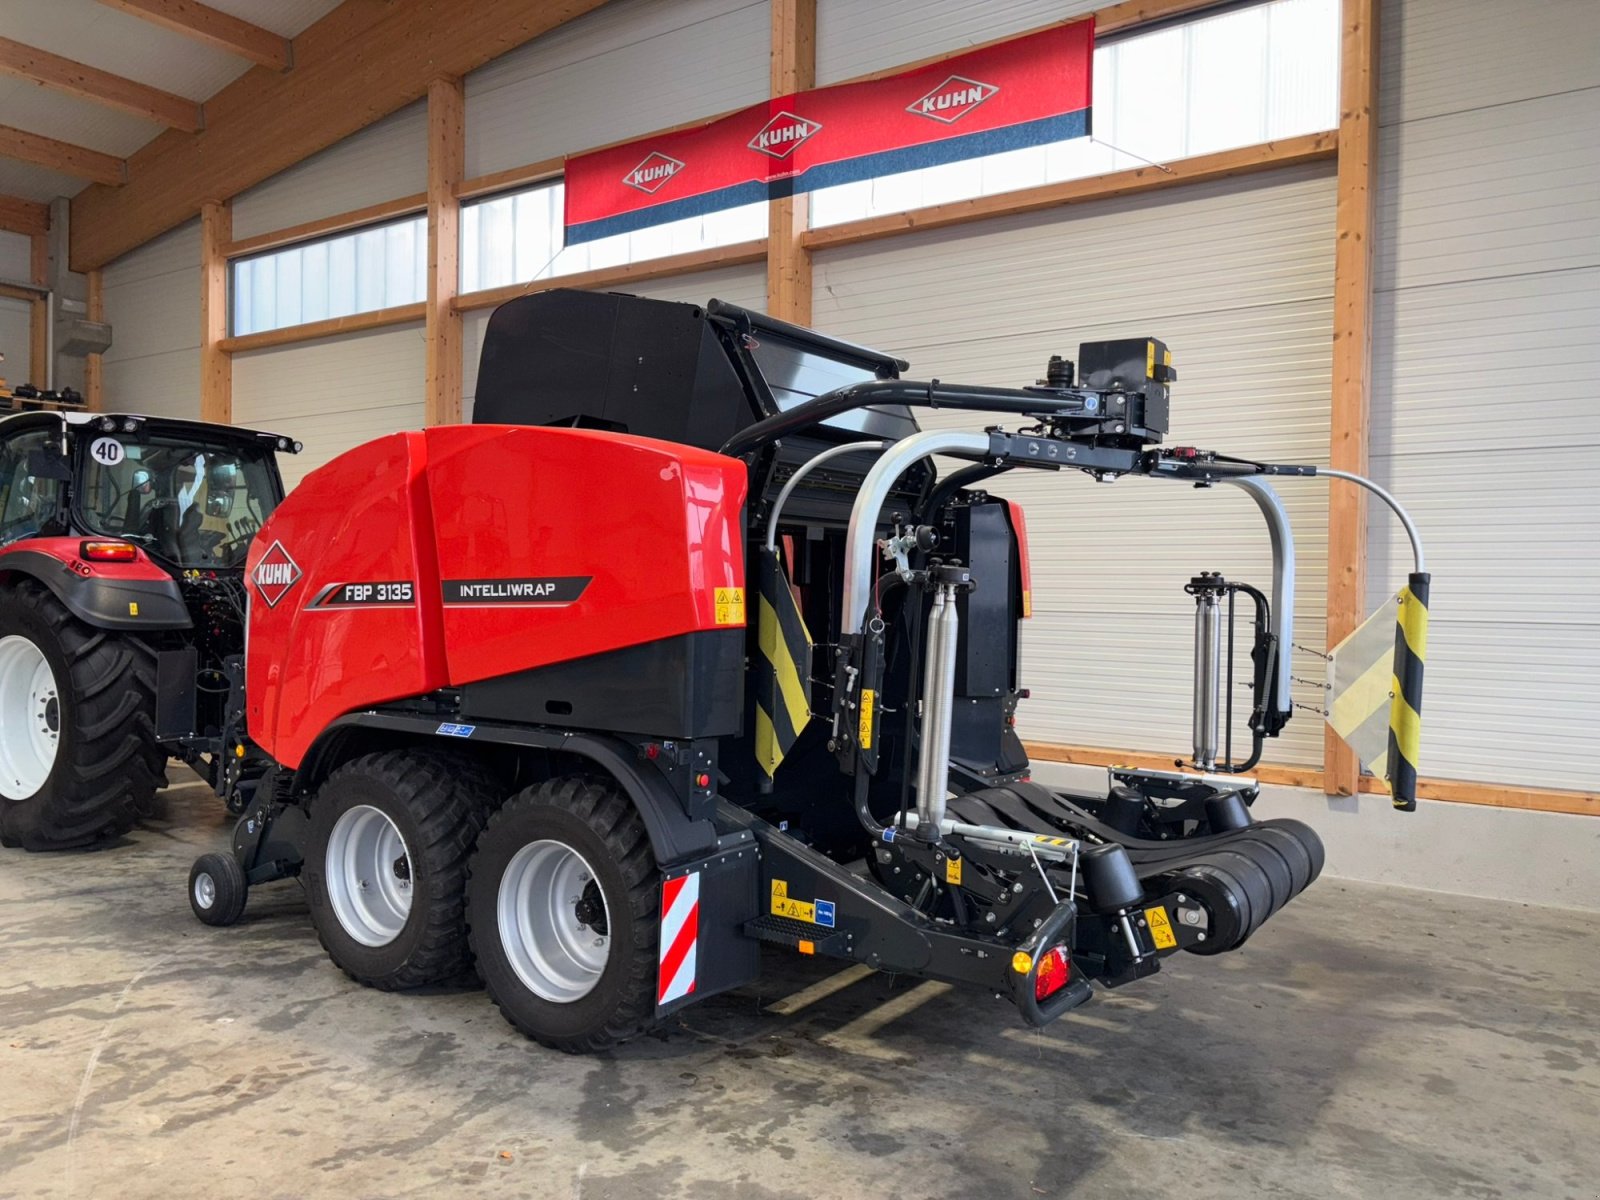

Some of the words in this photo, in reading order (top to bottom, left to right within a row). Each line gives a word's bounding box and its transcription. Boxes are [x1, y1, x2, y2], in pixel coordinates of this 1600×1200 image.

[922, 86, 983, 113] KUHN
[760, 122, 807, 148] KUHN
[634, 162, 675, 185] KUHN
[95, 441, 118, 461] 40
[258, 563, 292, 585] KUHN
[345, 585, 373, 601] FBP
[377, 584, 412, 600] 3135
[460, 583, 556, 597] INTELLIWRAP
